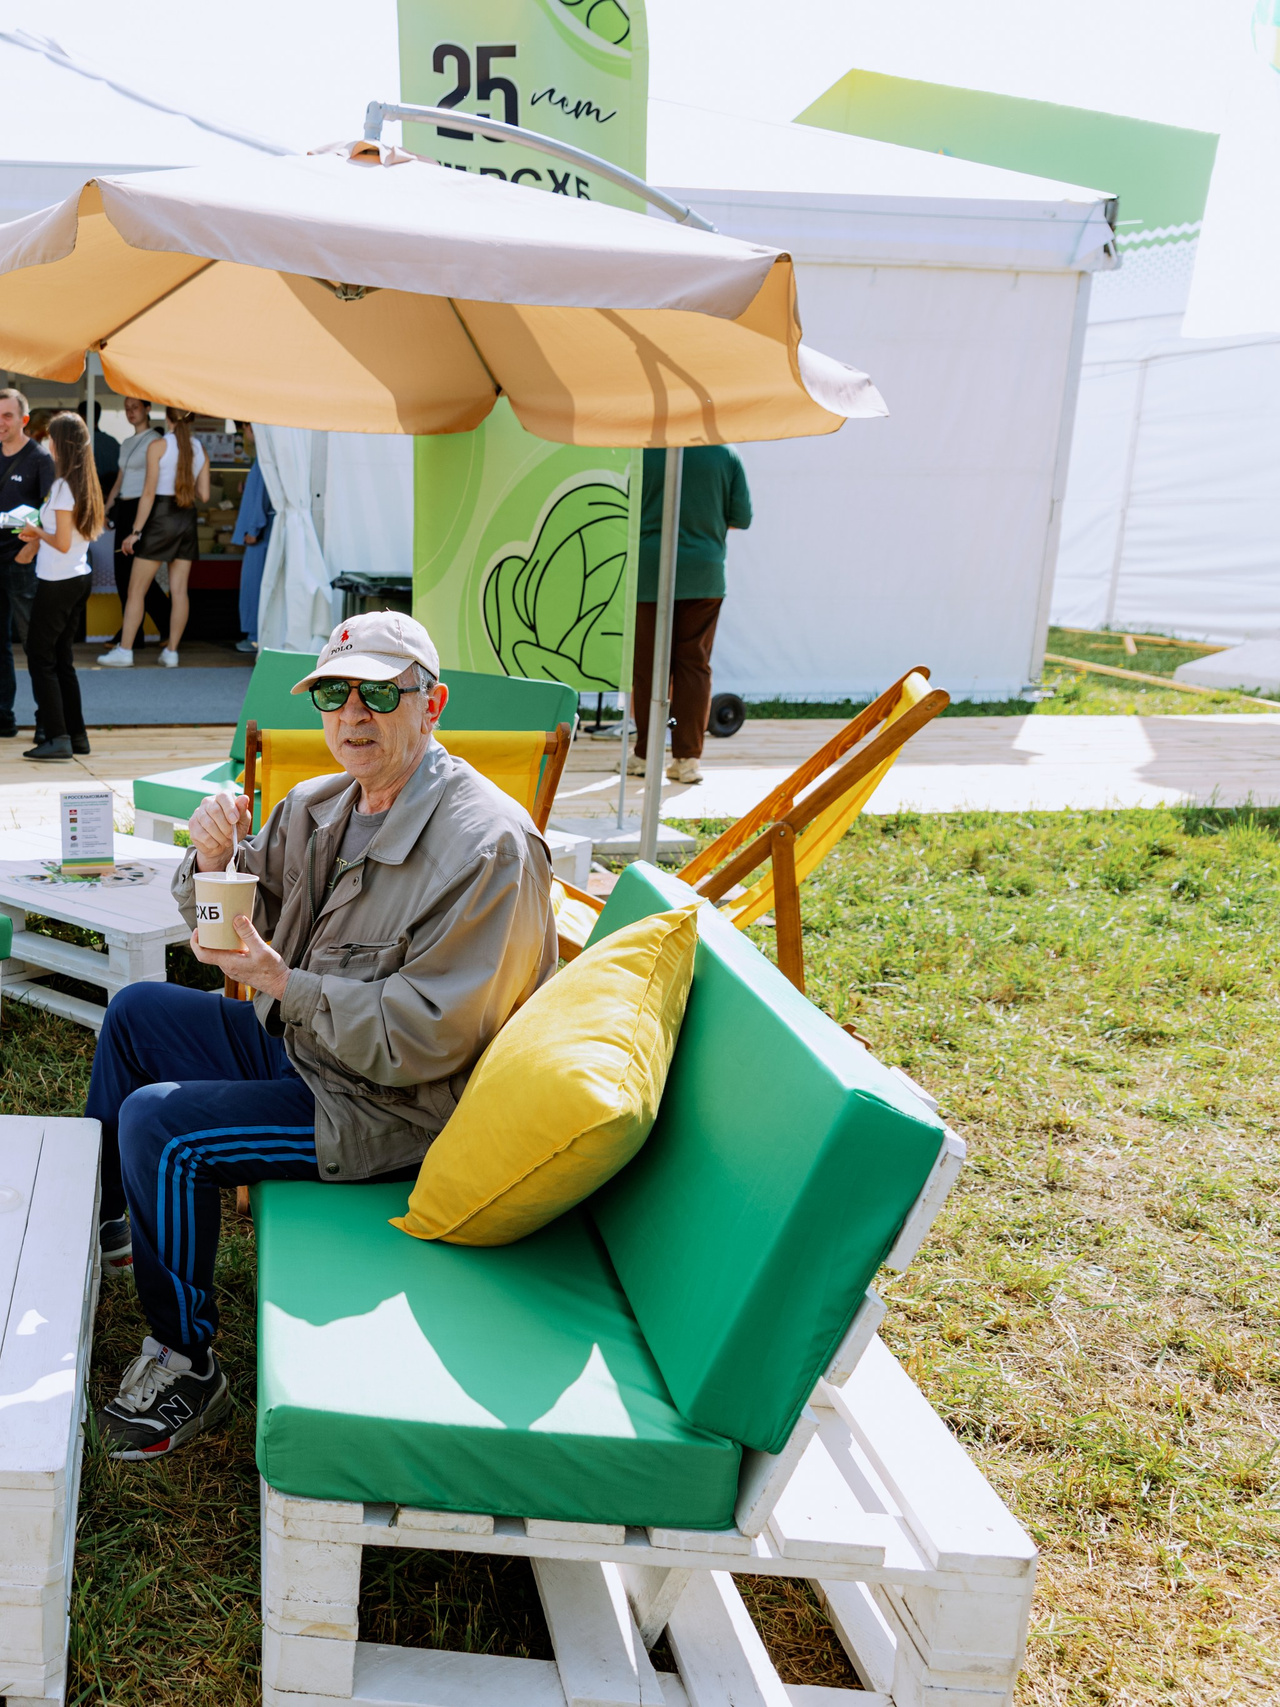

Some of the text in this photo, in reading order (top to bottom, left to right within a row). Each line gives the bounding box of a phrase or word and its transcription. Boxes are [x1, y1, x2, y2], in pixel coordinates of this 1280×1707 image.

[433, 44, 519, 143] 25
[331, 643, 353, 655] POLO
[157, 1394, 194, 1429] N
